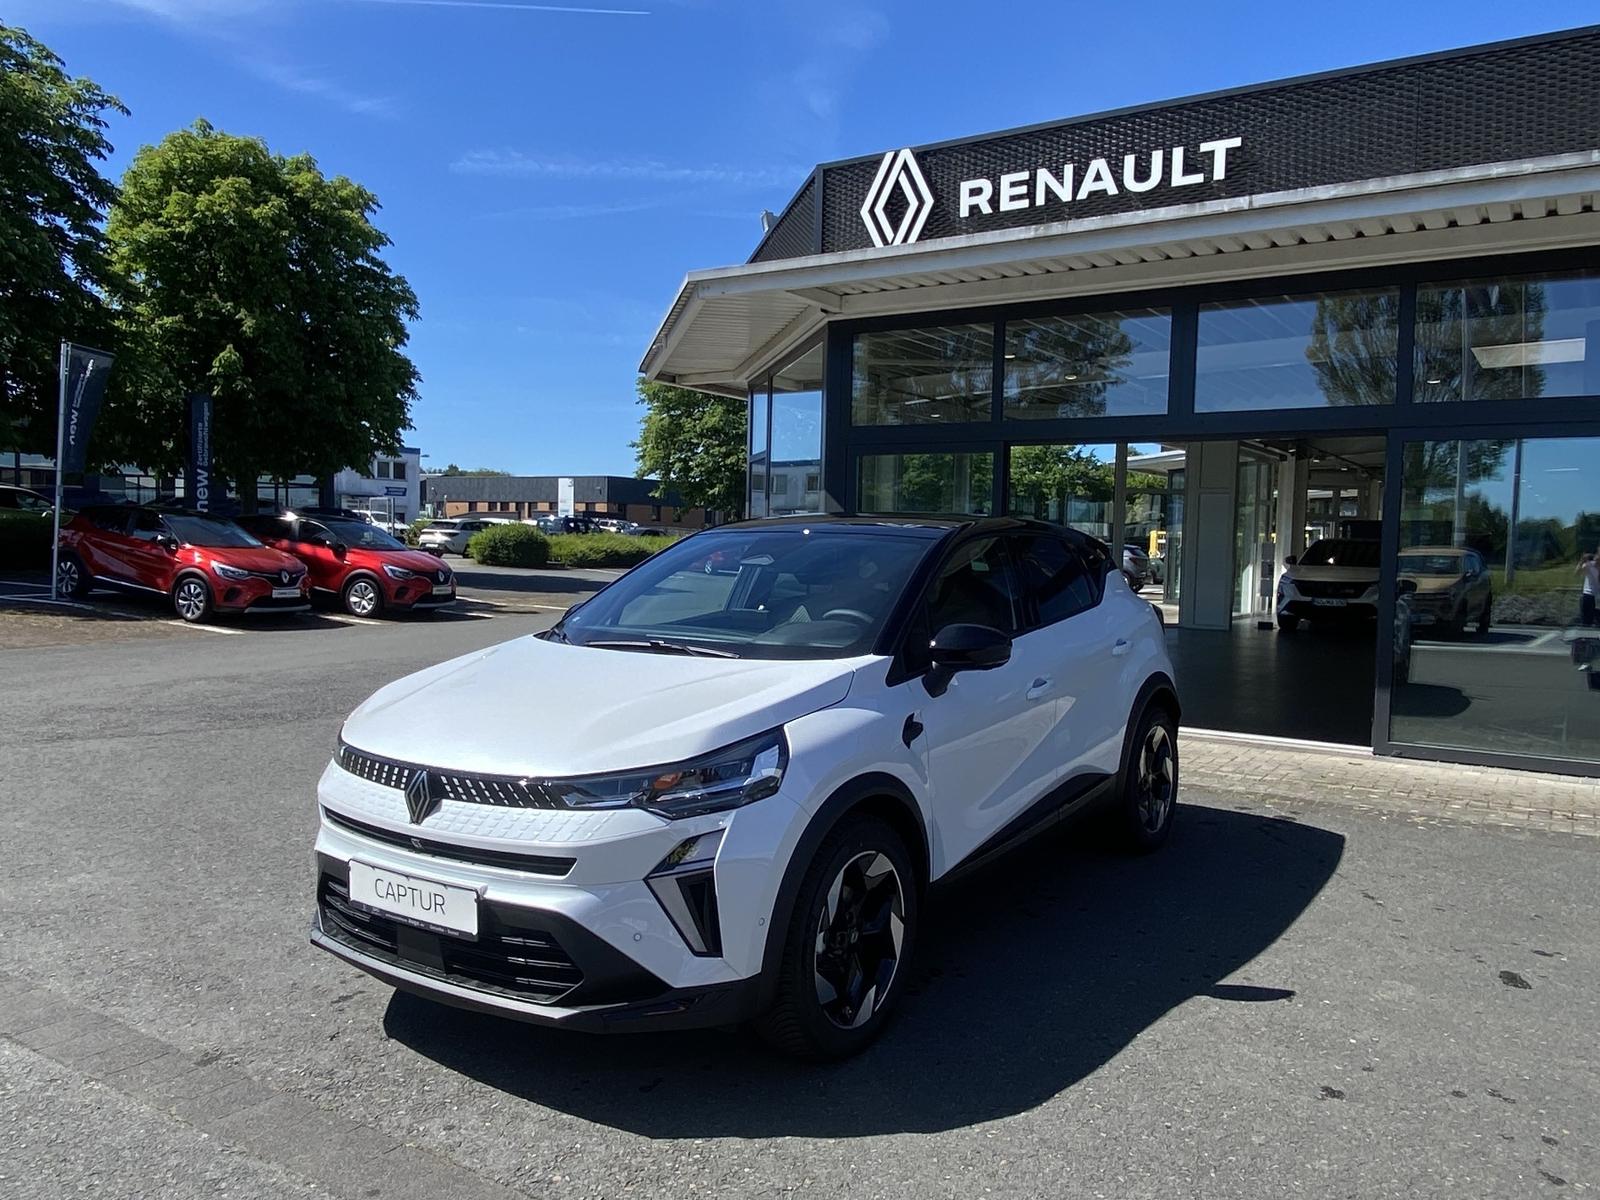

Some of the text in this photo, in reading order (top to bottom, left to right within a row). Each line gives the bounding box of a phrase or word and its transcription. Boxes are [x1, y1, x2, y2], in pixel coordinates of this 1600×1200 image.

[959, 137, 1242, 218] RENAULT
[197, 469, 209, 512] new
[374, 878, 446, 915] CAPTUR
